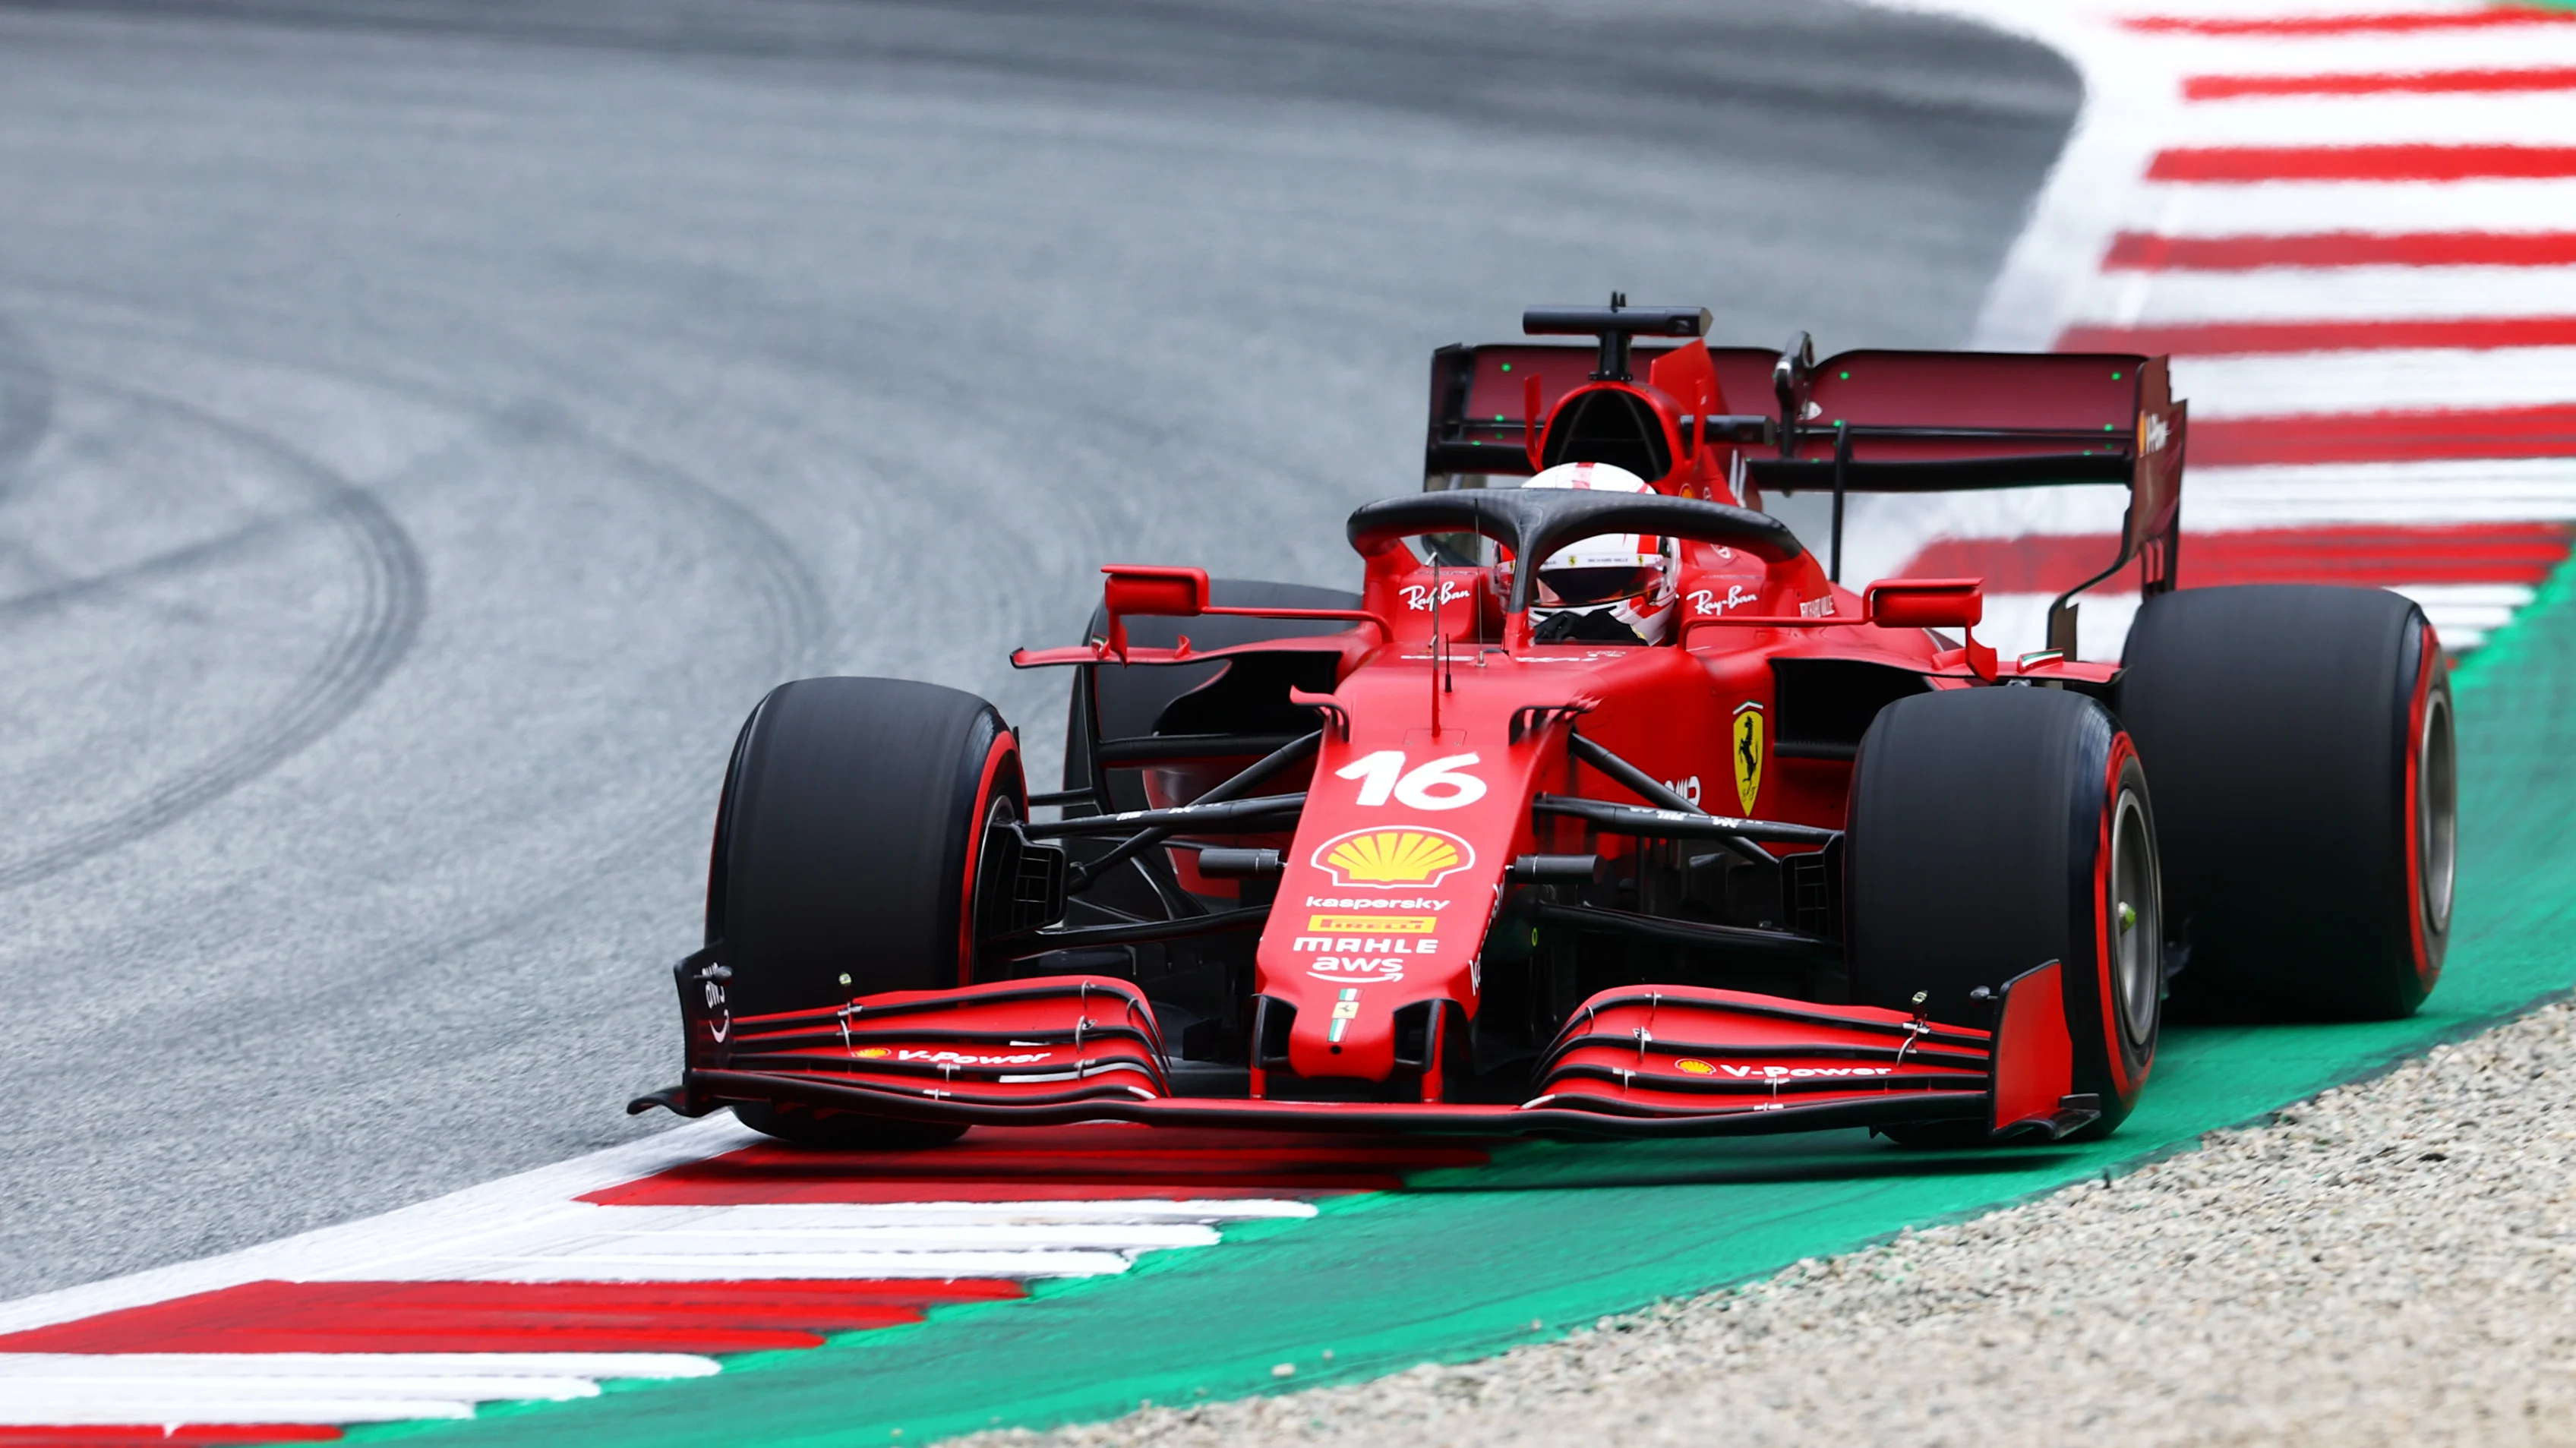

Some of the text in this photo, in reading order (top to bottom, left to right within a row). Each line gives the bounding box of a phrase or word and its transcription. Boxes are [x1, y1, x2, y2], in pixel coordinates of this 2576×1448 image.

[1399, 581, 1470, 612] Ray-Ban
[1686, 585, 1757, 617] Ray-Ban
[1334, 749, 1488, 811] 16
[1305, 896, 1451, 910] kaspersky
[1318, 917, 1425, 930] PIRELLI
[1293, 937, 1439, 954] MAHLE
[1312, 956, 1404, 973] aws
[898, 1049, 1052, 1064] V-Power
[1719, 1064, 1893, 1077] V-Power
